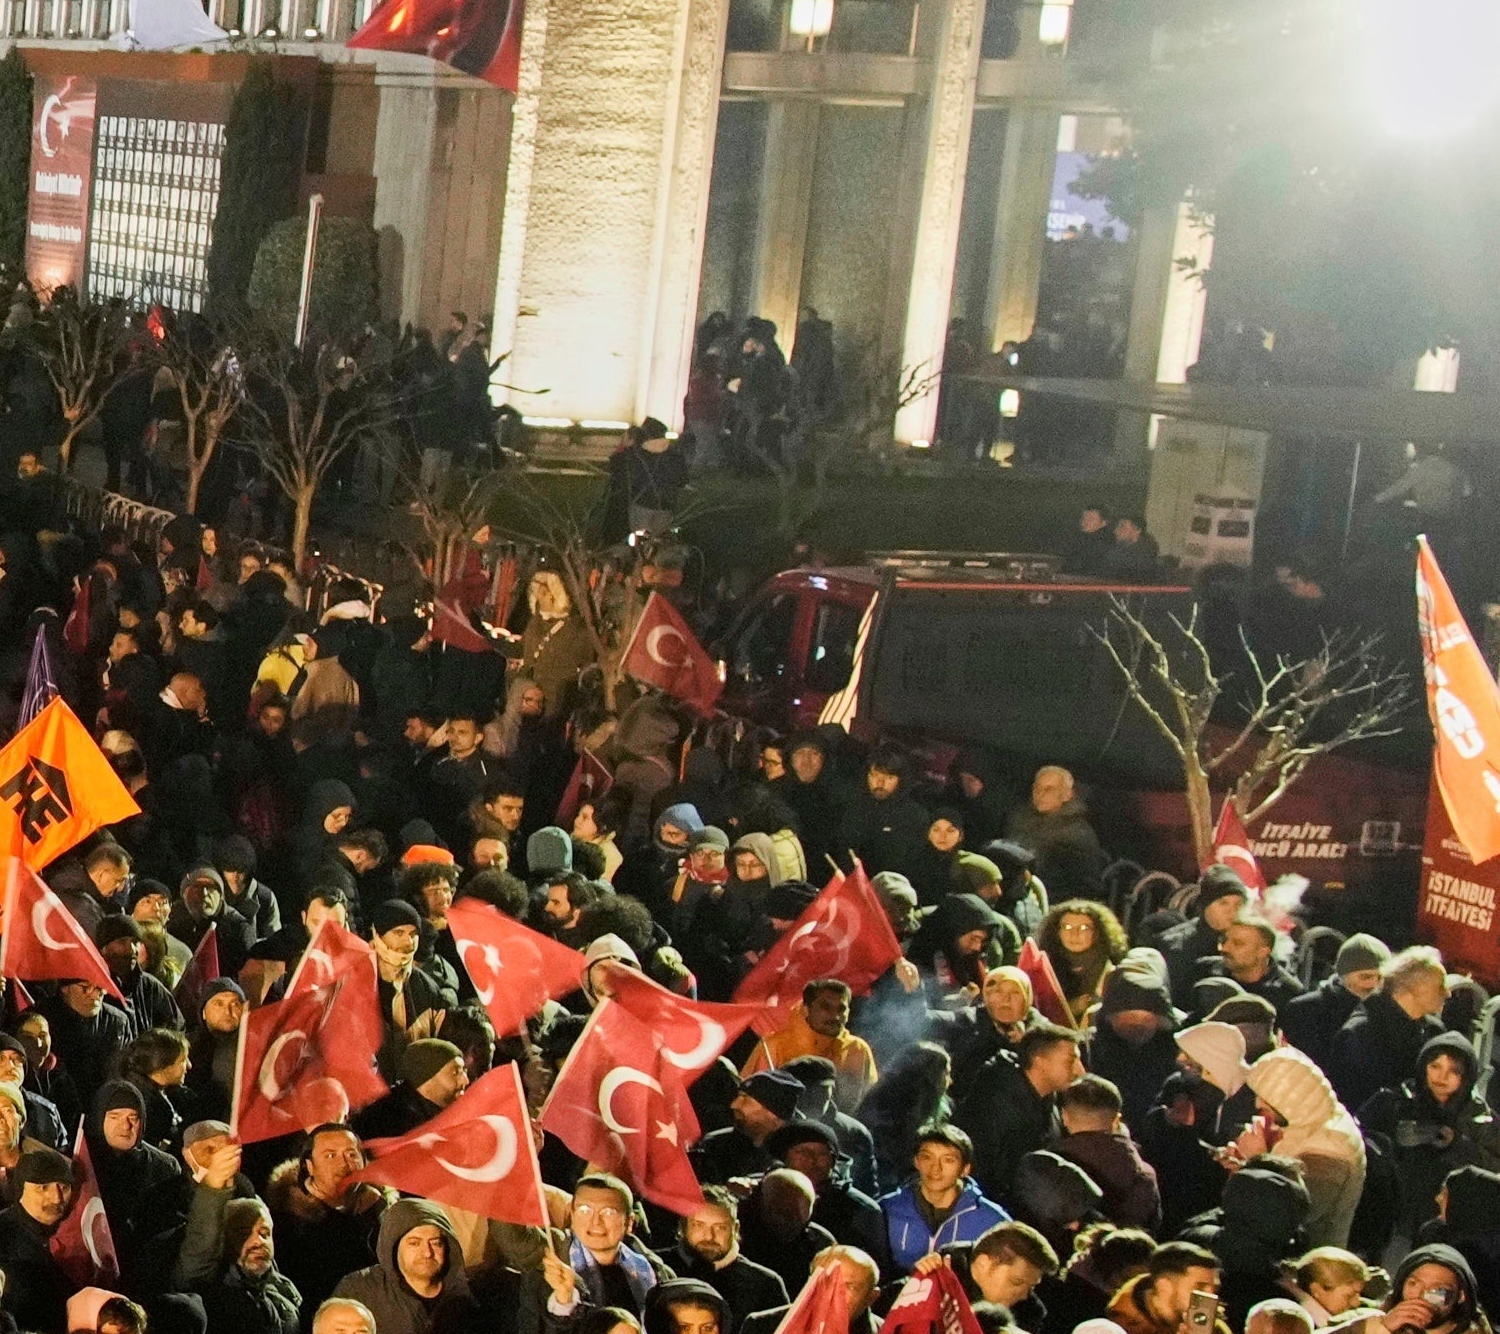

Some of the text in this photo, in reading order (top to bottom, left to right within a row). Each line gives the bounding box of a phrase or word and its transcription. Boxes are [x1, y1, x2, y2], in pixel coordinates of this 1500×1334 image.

[1260, 821, 1333, 840] İTFAİYE
[1427, 870, 1497, 910] İSTANBUL
[1425, 894, 1494, 933] İTFAİYESİ
